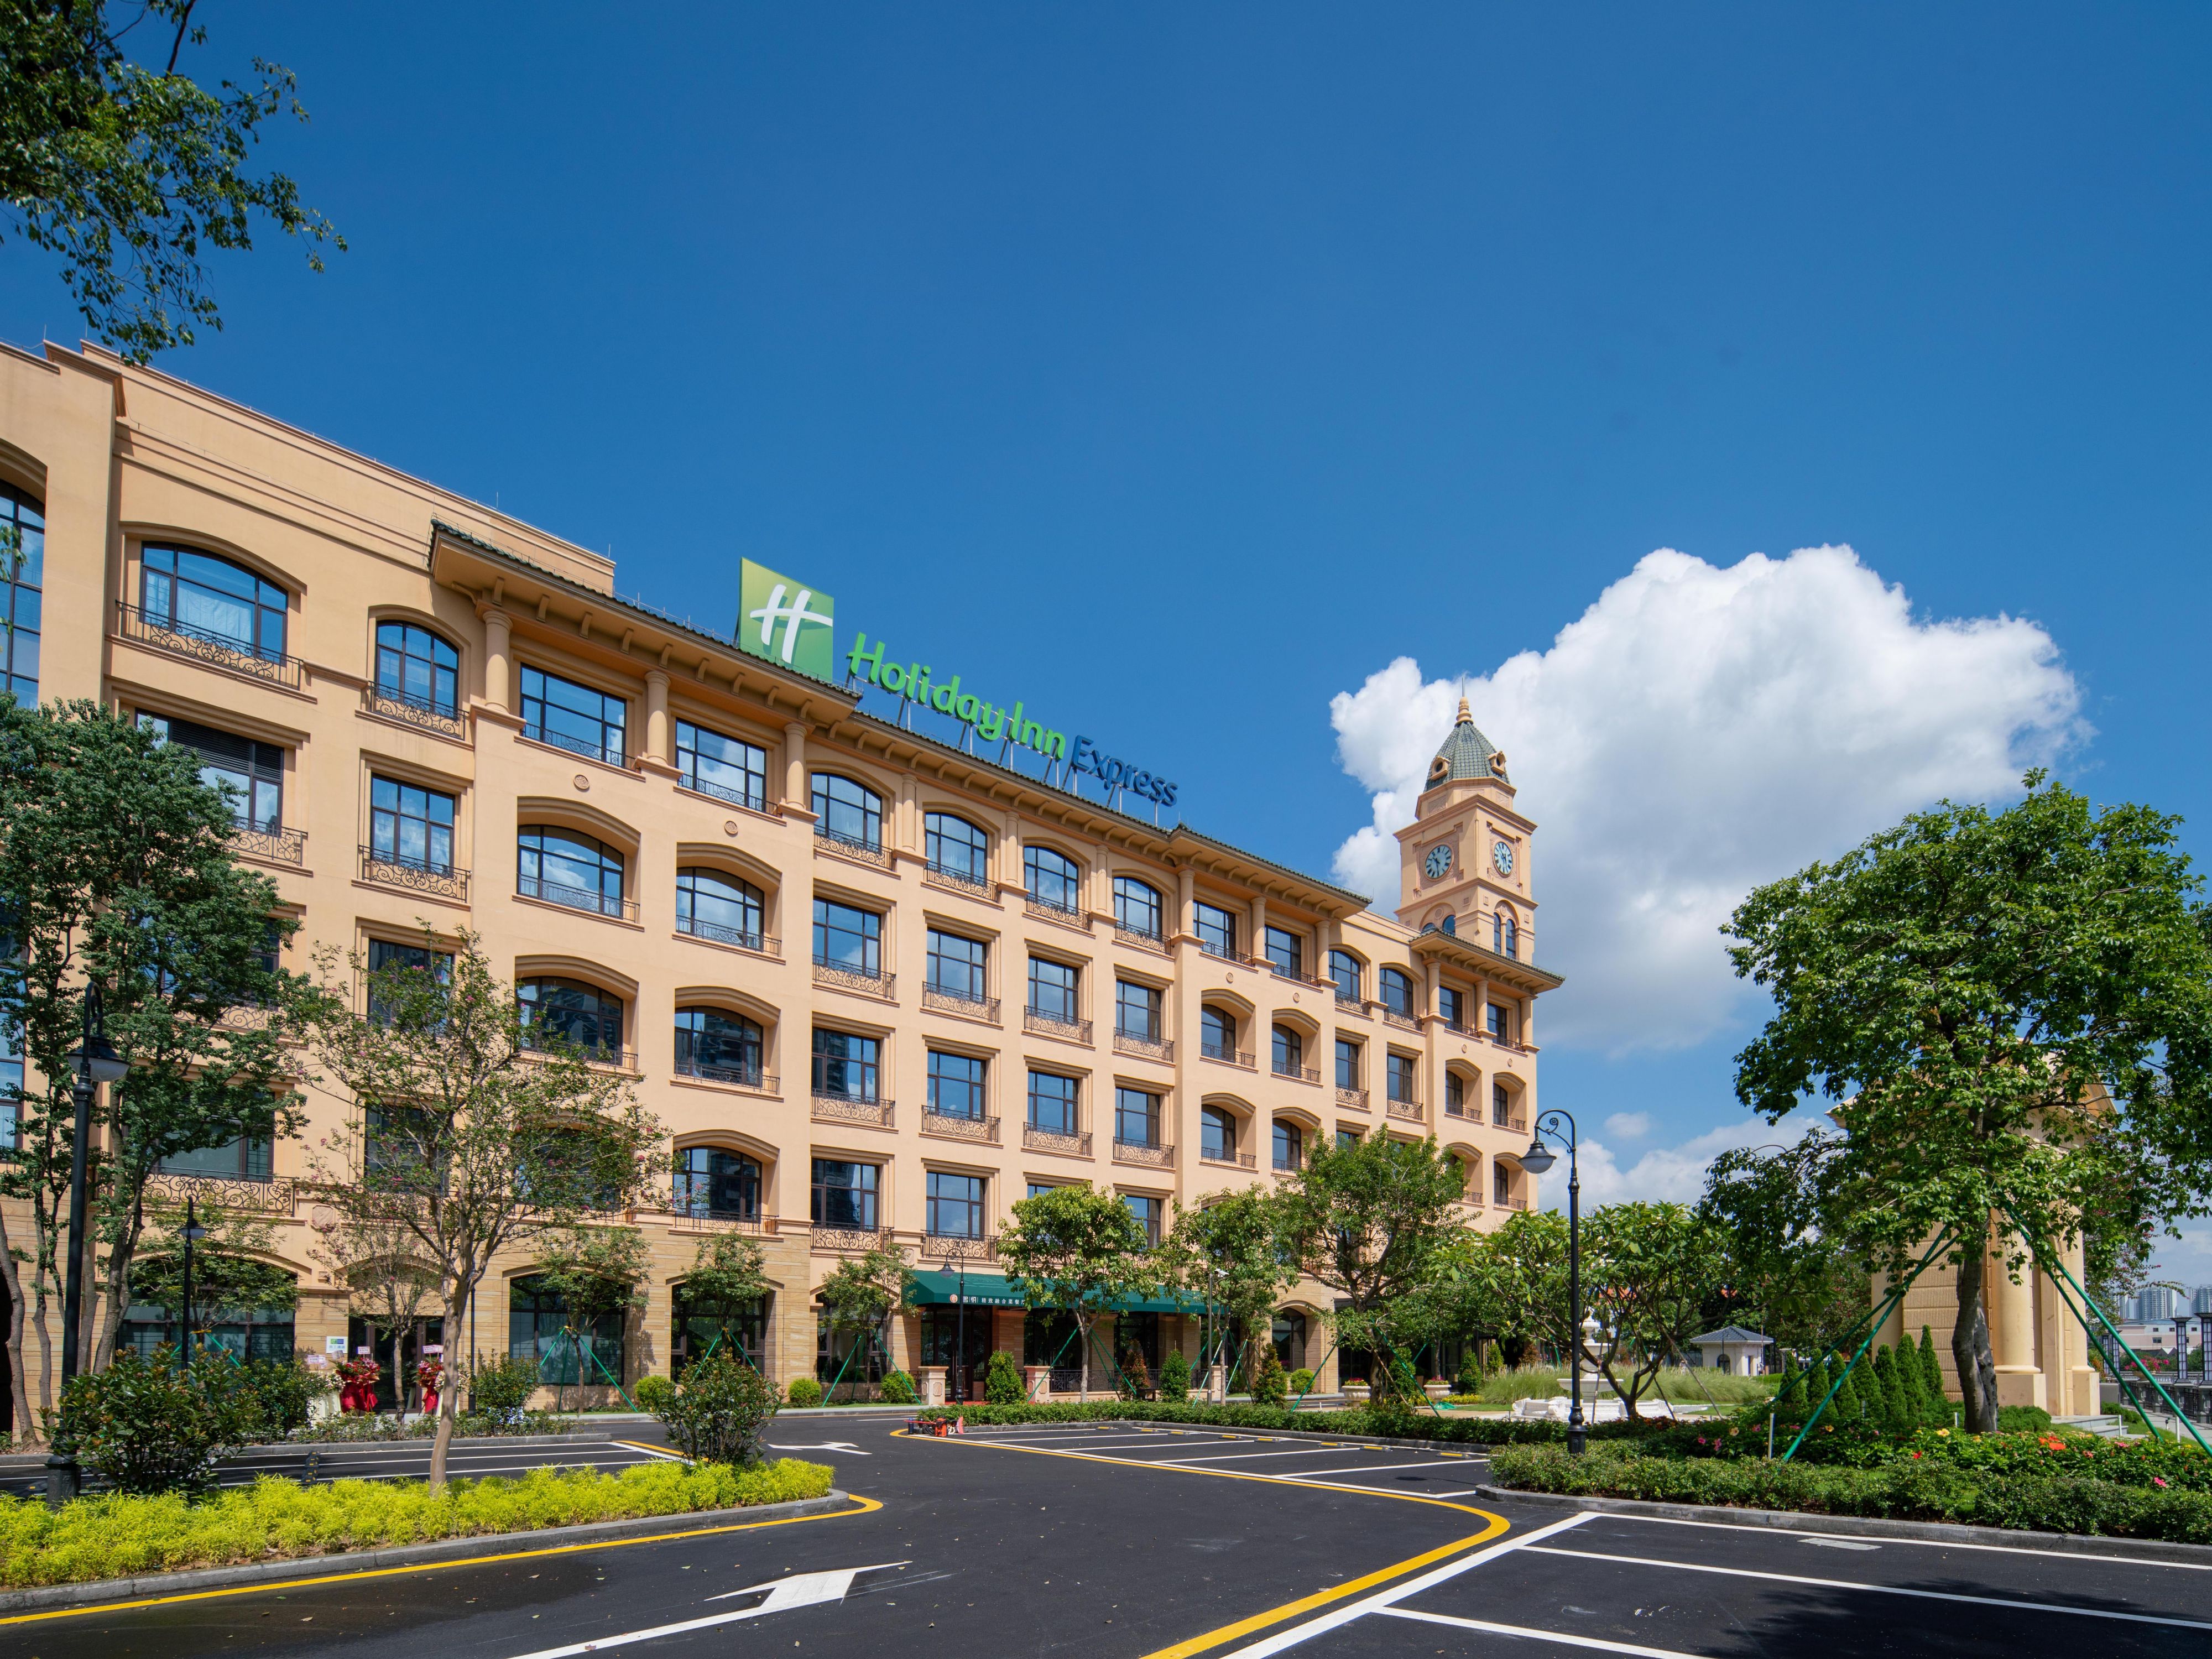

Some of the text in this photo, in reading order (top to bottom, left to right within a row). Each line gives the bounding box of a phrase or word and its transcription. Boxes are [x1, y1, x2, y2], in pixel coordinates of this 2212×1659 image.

[846, 632, 1178, 806] Holiday Inn Express
